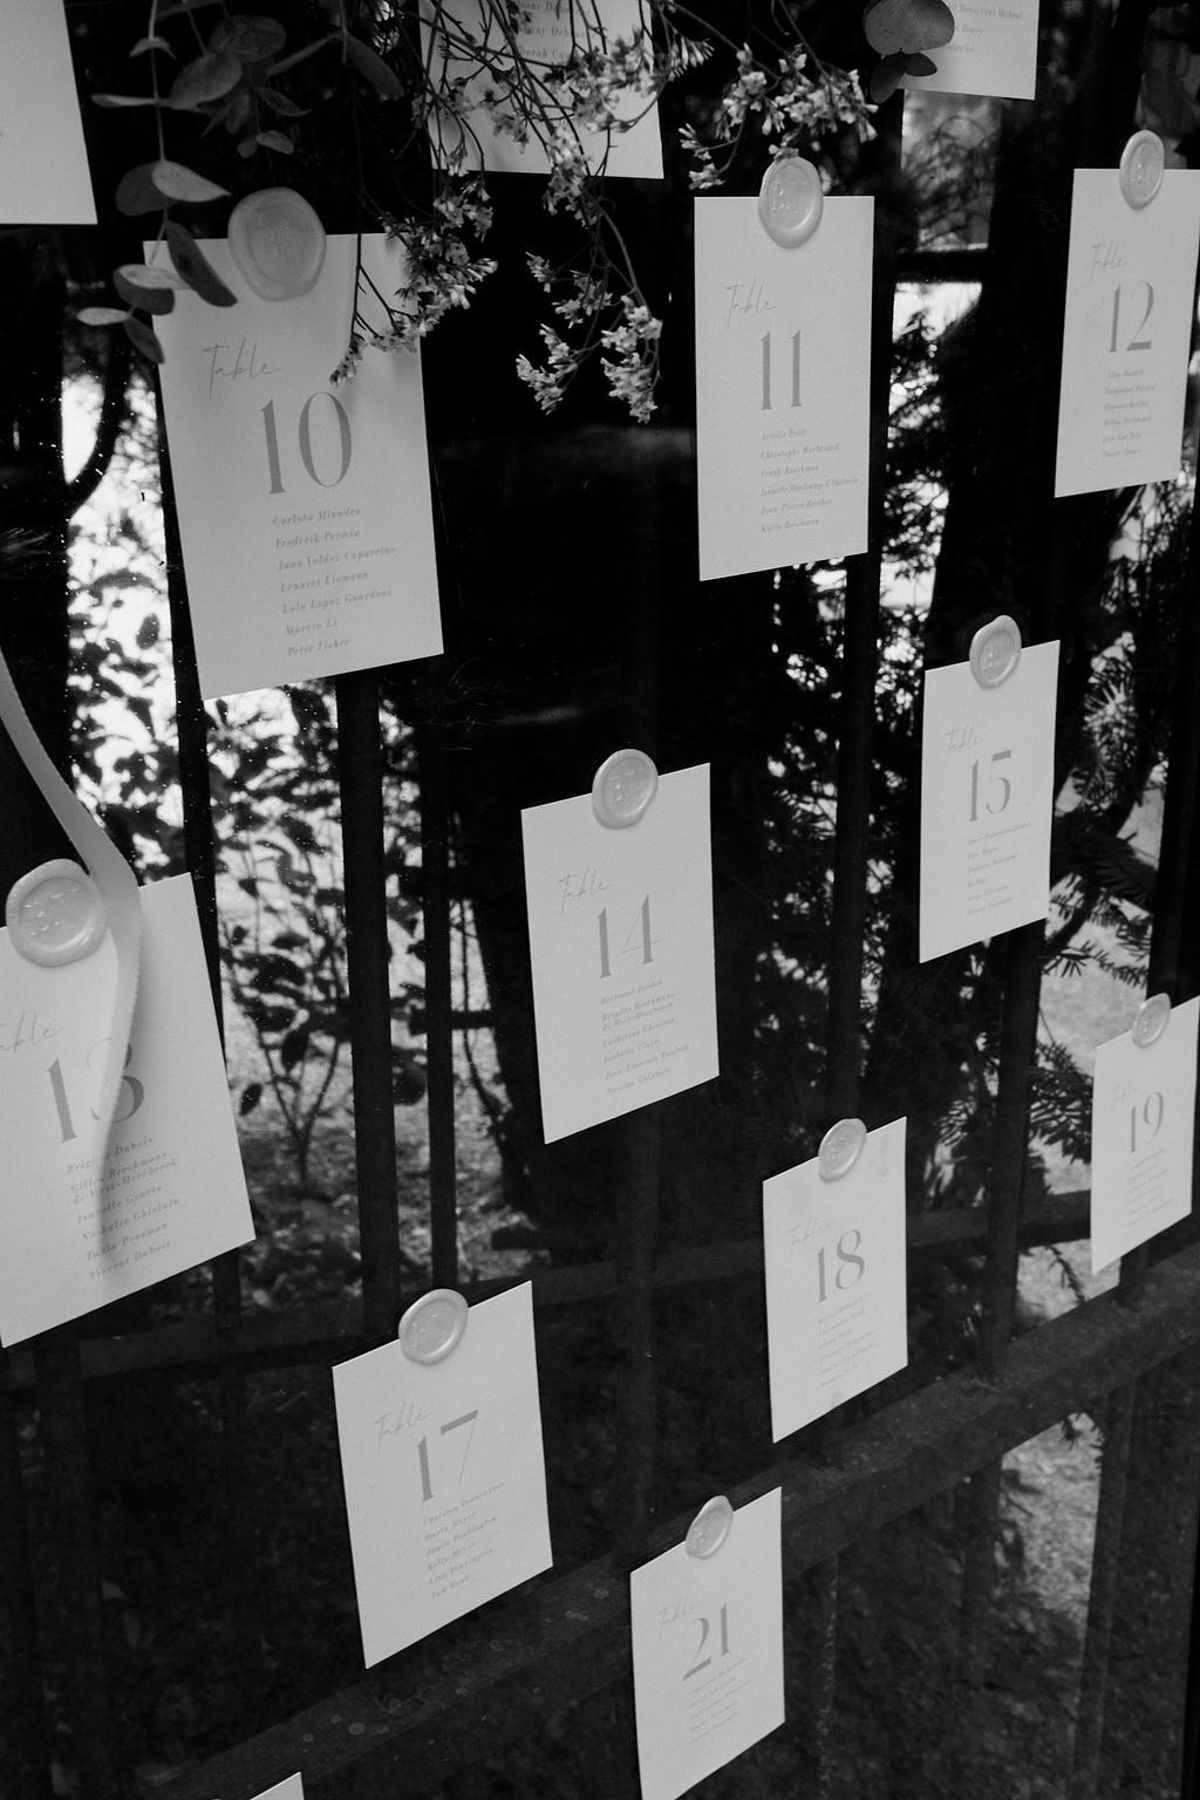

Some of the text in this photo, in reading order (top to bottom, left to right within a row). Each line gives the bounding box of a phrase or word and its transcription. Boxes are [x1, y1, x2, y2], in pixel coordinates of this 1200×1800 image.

[1089, 240, 1127, 282] Table
[726, 279, 779, 330] Table
[1109, 280, 1154, 352] 12
[202, 337, 283, 403] Table
[761, 328, 802, 410] 11
[258, 391, 352, 494] 10
[273, 512, 313, 525] Carlota
[276, 533, 320, 548] Frederik
[278, 560, 303, 571] Juan
[288, 645, 314, 657] Peter
[945, 721, 984, 763] Table
[969, 749, 1012, 822] 15
[558, 866, 614, 918] Table
[596, 893, 662, 979] 14
[1129, 1090, 1164, 1154] 19
[818, 1229, 865, 1303] 18
[373, 1401, 433, 1454] Table
[416, 1409, 479, 1502] 17
[682, 1602, 730, 1681] 21
